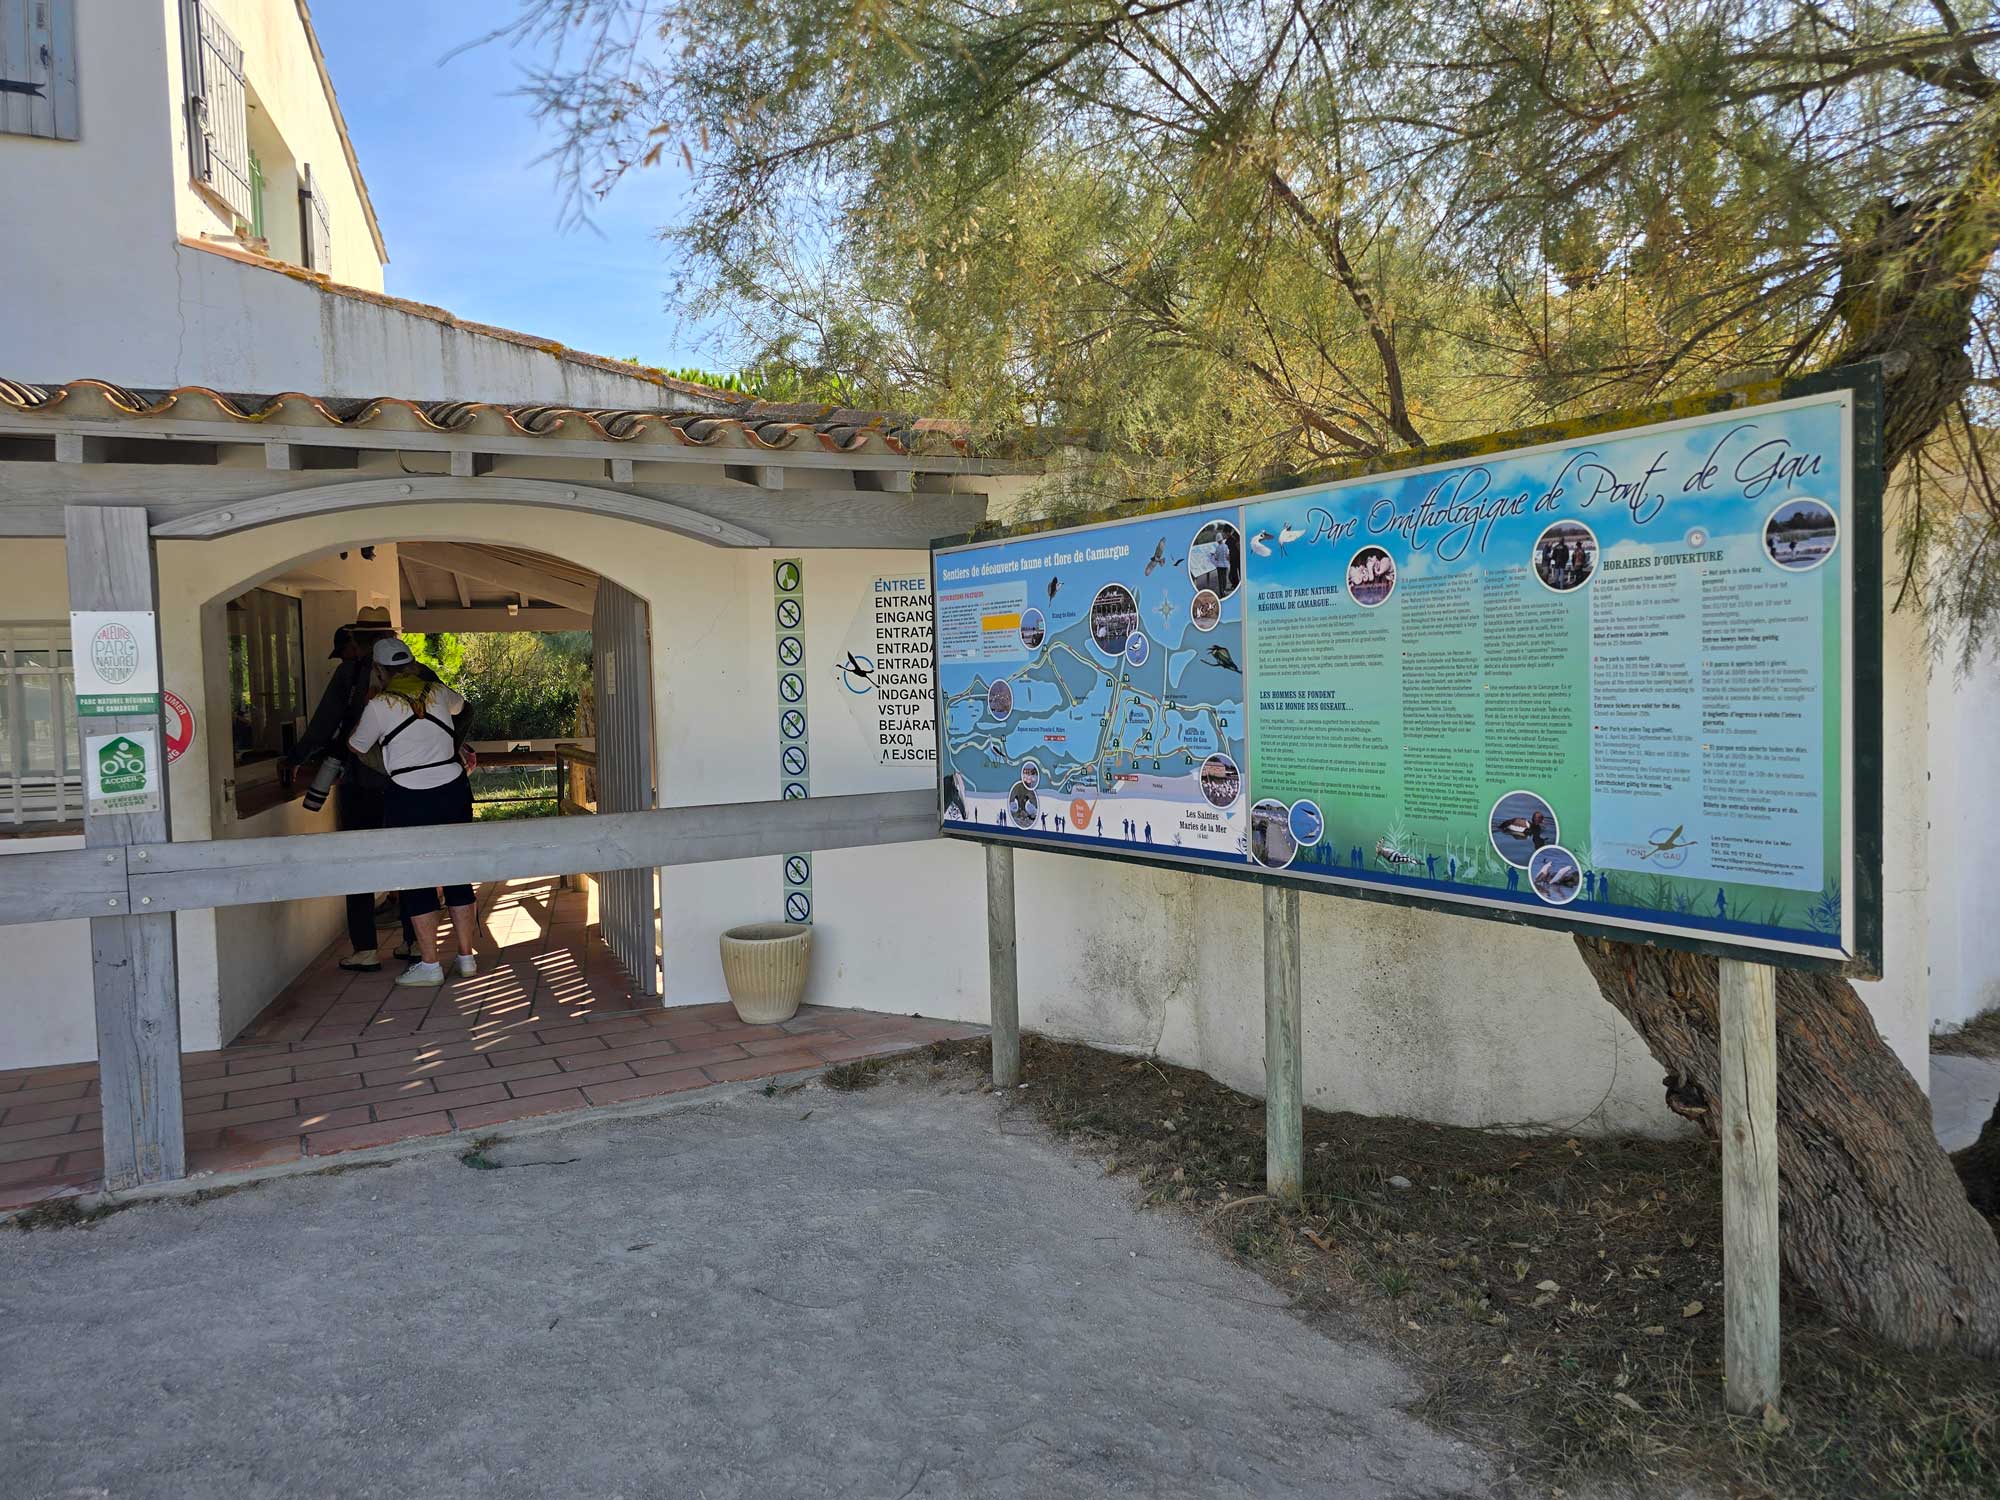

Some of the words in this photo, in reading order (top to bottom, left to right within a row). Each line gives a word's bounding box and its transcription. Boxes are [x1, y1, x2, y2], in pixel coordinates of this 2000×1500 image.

[1307, 507, 1357, 547] Parc
[1368, 467, 1529, 561] Ornithologique
[1535, 451, 1599, 511] de
[1577, 450, 1669, 524] Pont
[1683, 424, 1759, 492] de
[1735, 438, 1822, 499] Gau
[943, 569, 970, 581] Sentiers
[972, 567, 980, 577] de
[981, 562, 1019, 576] découverte
[1020, 557, 1042, 571] faune
[1044, 556, 1052, 567] et
[1054, 553, 1072, 566] flore
[1074, 550, 1084, 562] de
[1086, 544, 1130, 561] Camargue
[1603, 557, 1651, 571] HORAIRES
[1654, 550, 1724, 567] D'OUVERTURE
[875, 578, 926, 592] ENTREE
[1258, 592, 1266, 600] AU
[1266, 590, 1284, 599] CŒUR
[1285, 589, 1293, 598] DU
[1294, 588, 1309, 597] PARC
[1310, 585, 1339, 596] NATUREL
[1258, 601, 1287, 611] RÉGIONAL
[1288, 601, 1296, 609] DE
[876, 610, 934, 623] EINGANG
[876, 626, 933, 639] ENTRATA
[95, 640, 134, 656] PARC
[96, 655, 135, 667] NATUREL
[877, 673, 928, 685] INGANG
[1260, 690, 1271, 699] LES
[1272, 690, 1297, 699] HOMMES
[1298, 690, 1305, 699] SE
[1307, 690, 1336, 699] FONDENT
[80, 698, 97, 706] PARC
[97, 697, 123, 705] NATUREL
[1260, 702, 1275, 711] DANS
[1276, 702, 1284, 711] LE
[1285, 702, 1306, 711] MONDE
[1307, 702, 1319, 711] DES
[106, 704, 139, 712] CAMARGUE
[878, 704, 920, 715] VSTUP
[880, 733, 913, 746] ВХОД
[105, 775, 138, 785] ACCUEIL
[1186, 809, 1196, 818] Les
[1197, 810, 1219, 821] Saintes
[1179, 820, 1199, 831] Maries
[1200, 823, 1207, 832] de
[1208, 823, 1214, 832] la
[1215, 824, 1227, 834] Mer
